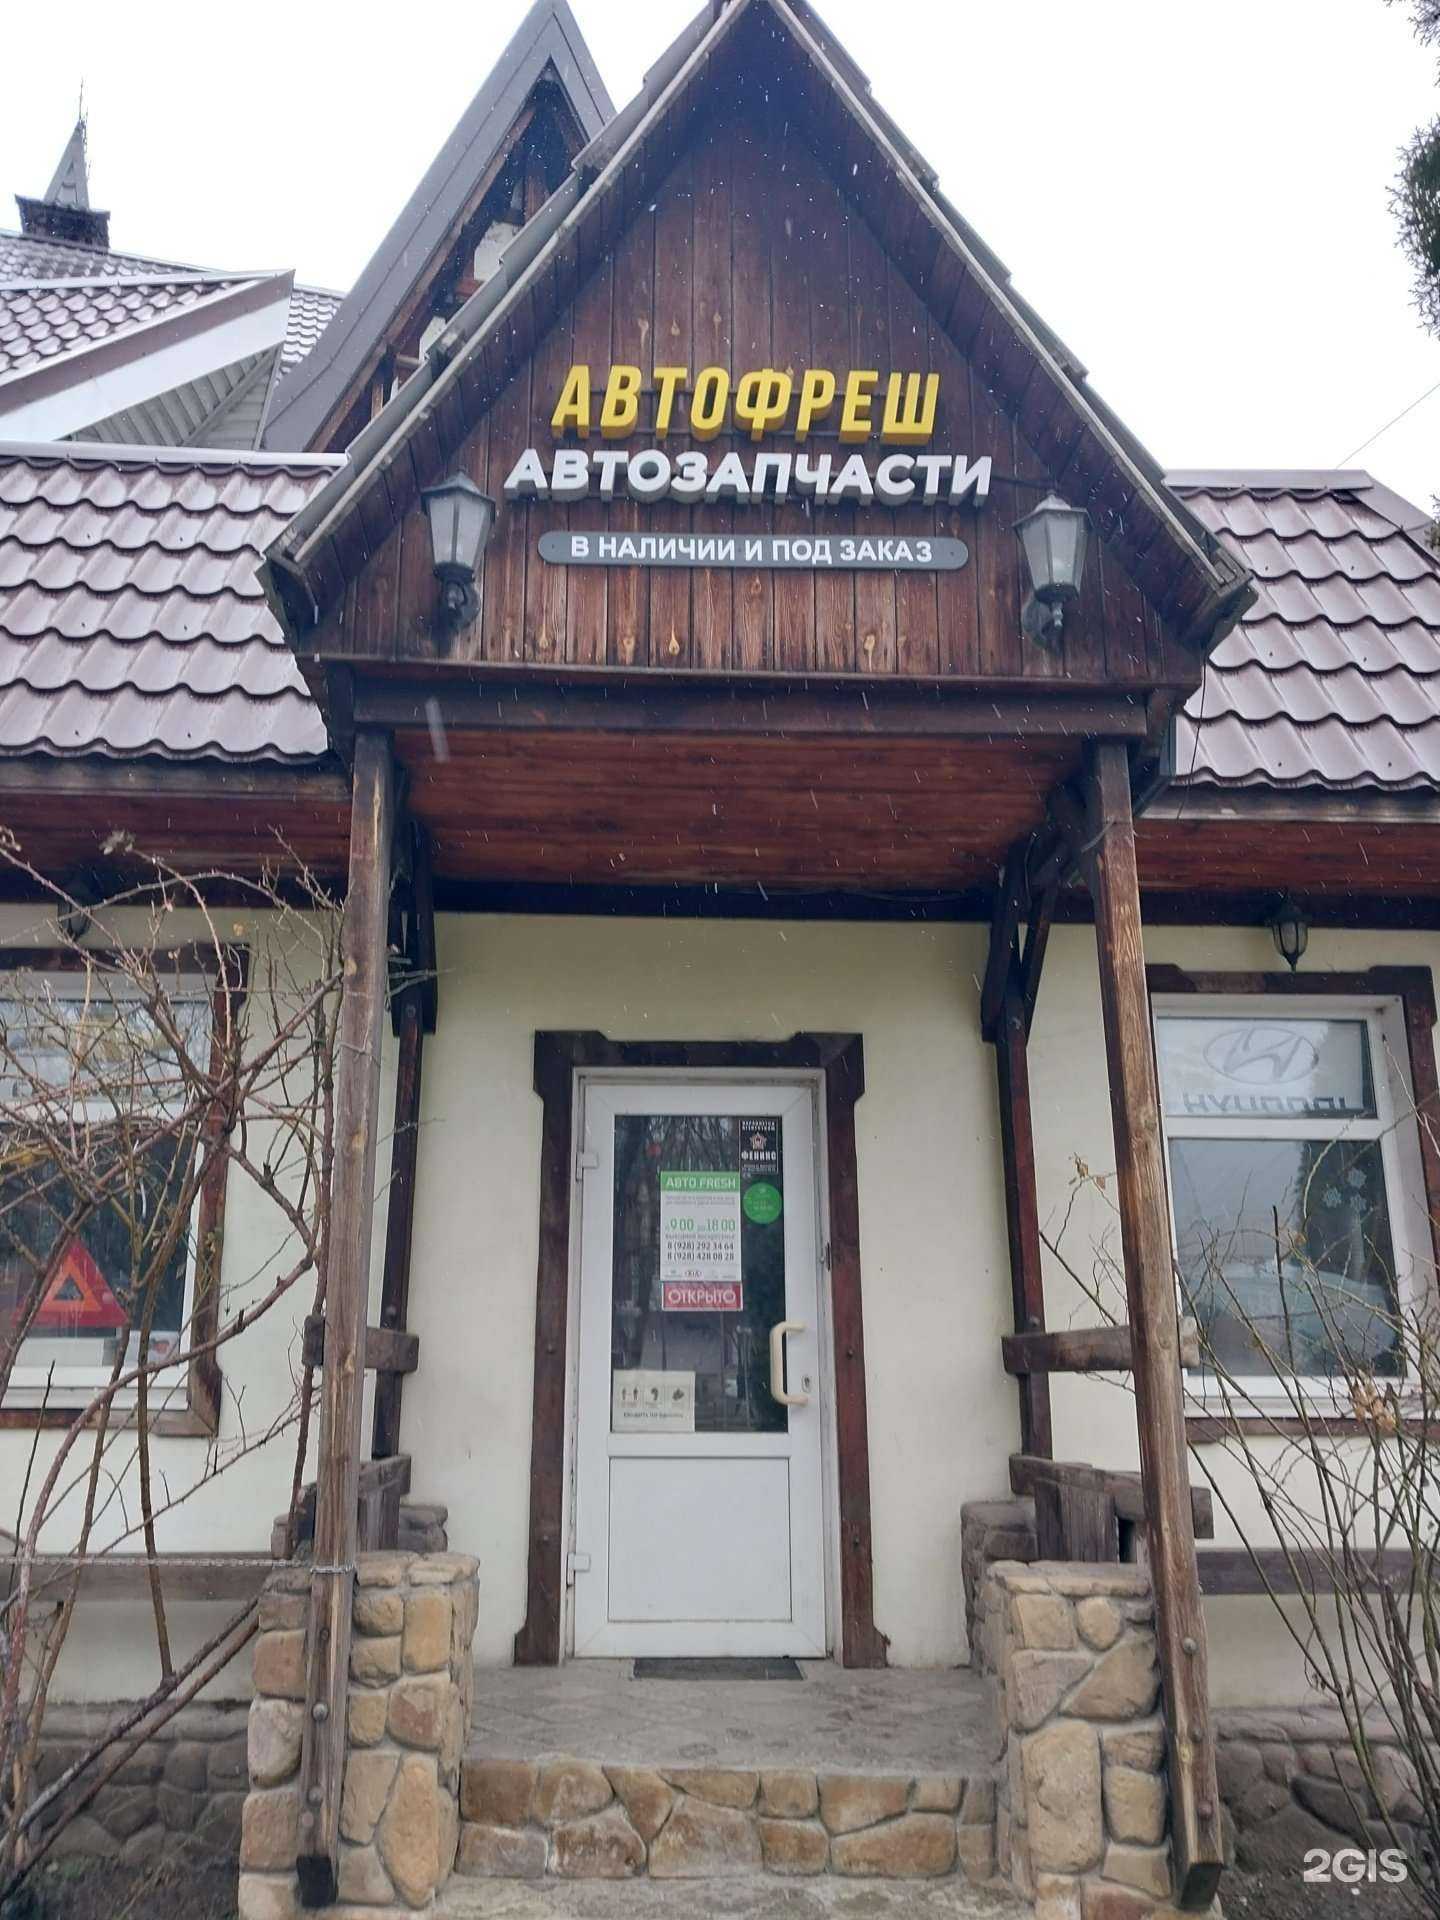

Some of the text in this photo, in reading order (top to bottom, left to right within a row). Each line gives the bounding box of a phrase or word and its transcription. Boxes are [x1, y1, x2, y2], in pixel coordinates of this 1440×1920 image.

[550, 364, 940, 445] АВТОФРЕШ
[503, 447, 993, 506] АВТОЗАПЧАСТИ
[571, 536, 933, 565] В НАЛИЧИИ И ПОД ЗАКАЗ
[668, 1289, 736, 1305] ОТКРЫТО
